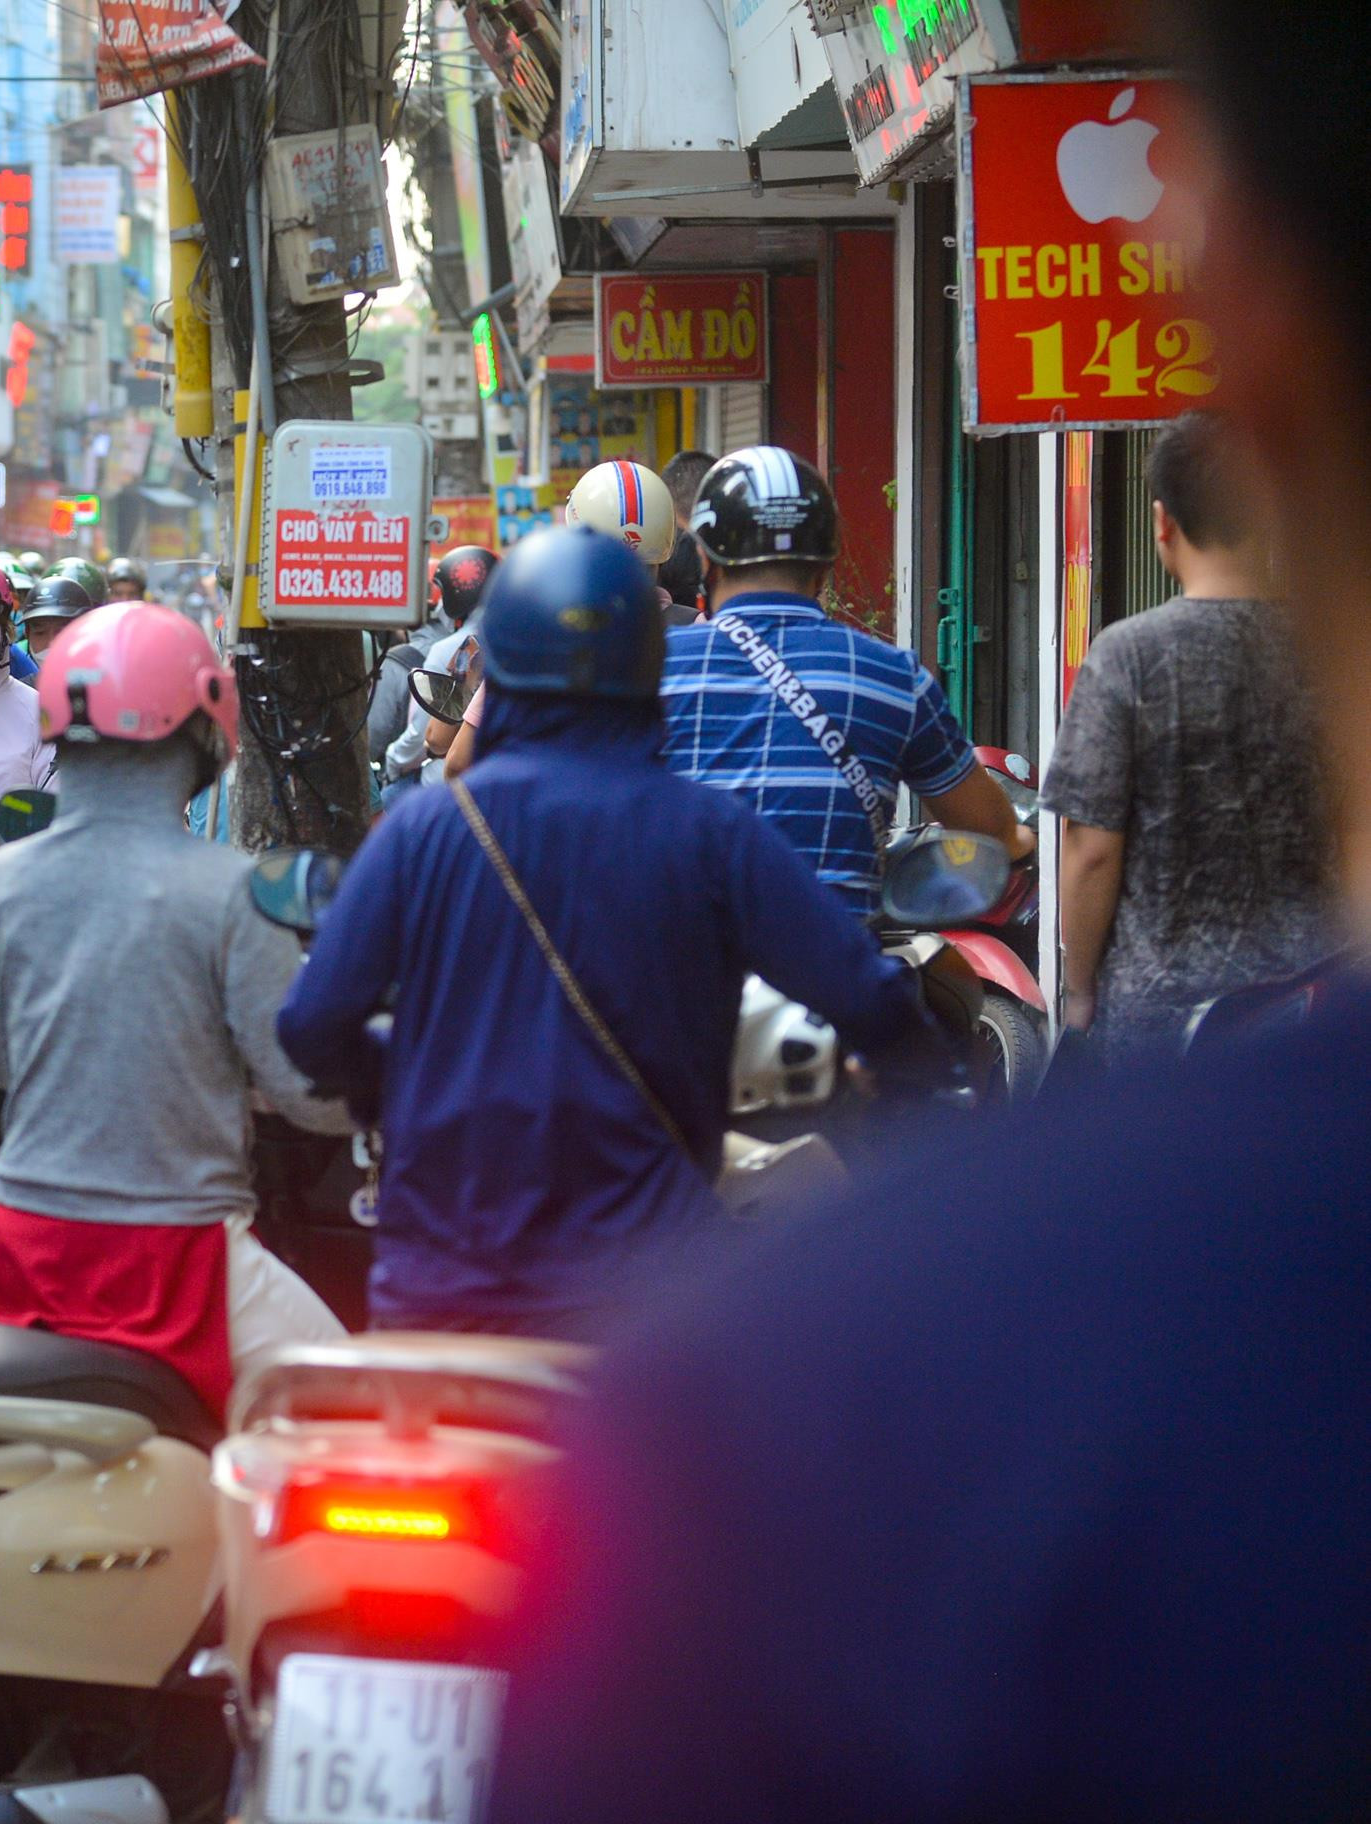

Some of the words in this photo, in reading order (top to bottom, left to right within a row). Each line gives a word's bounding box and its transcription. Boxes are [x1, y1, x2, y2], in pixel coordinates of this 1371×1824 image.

[977, 244, 1102, 300] TECH
[610, 284, 693, 363] CẦM
[702, 281, 756, 360] ĐỒ
[1014, 317, 1221, 400] 142
[281, 520, 318, 542] CHO
[323, 520, 356, 543] VAY
[279, 568, 403, 598] 0326.433.488
